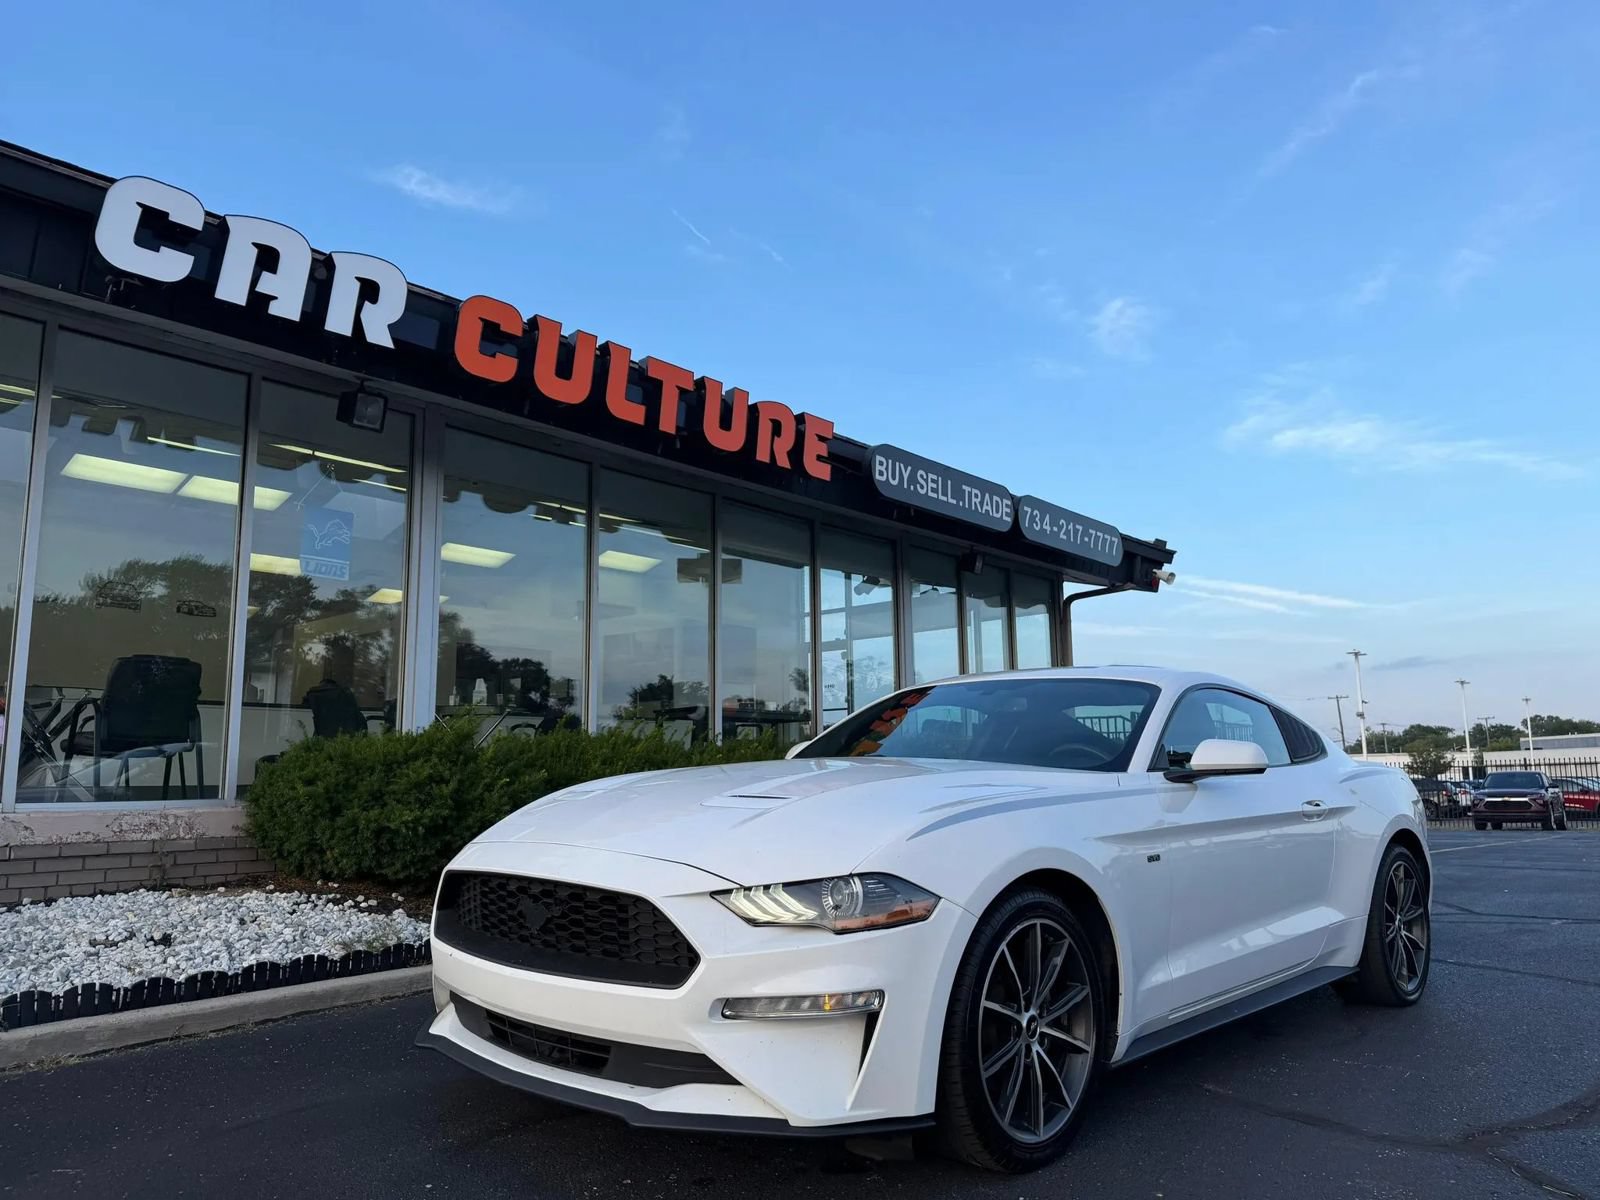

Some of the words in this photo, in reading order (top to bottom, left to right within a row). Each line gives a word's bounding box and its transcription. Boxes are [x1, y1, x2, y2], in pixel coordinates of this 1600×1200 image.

[95, 175, 408, 349] CAR
[454, 294, 834, 481] CULTURE
[1023, 505, 1119, 556] 734-217-7777
